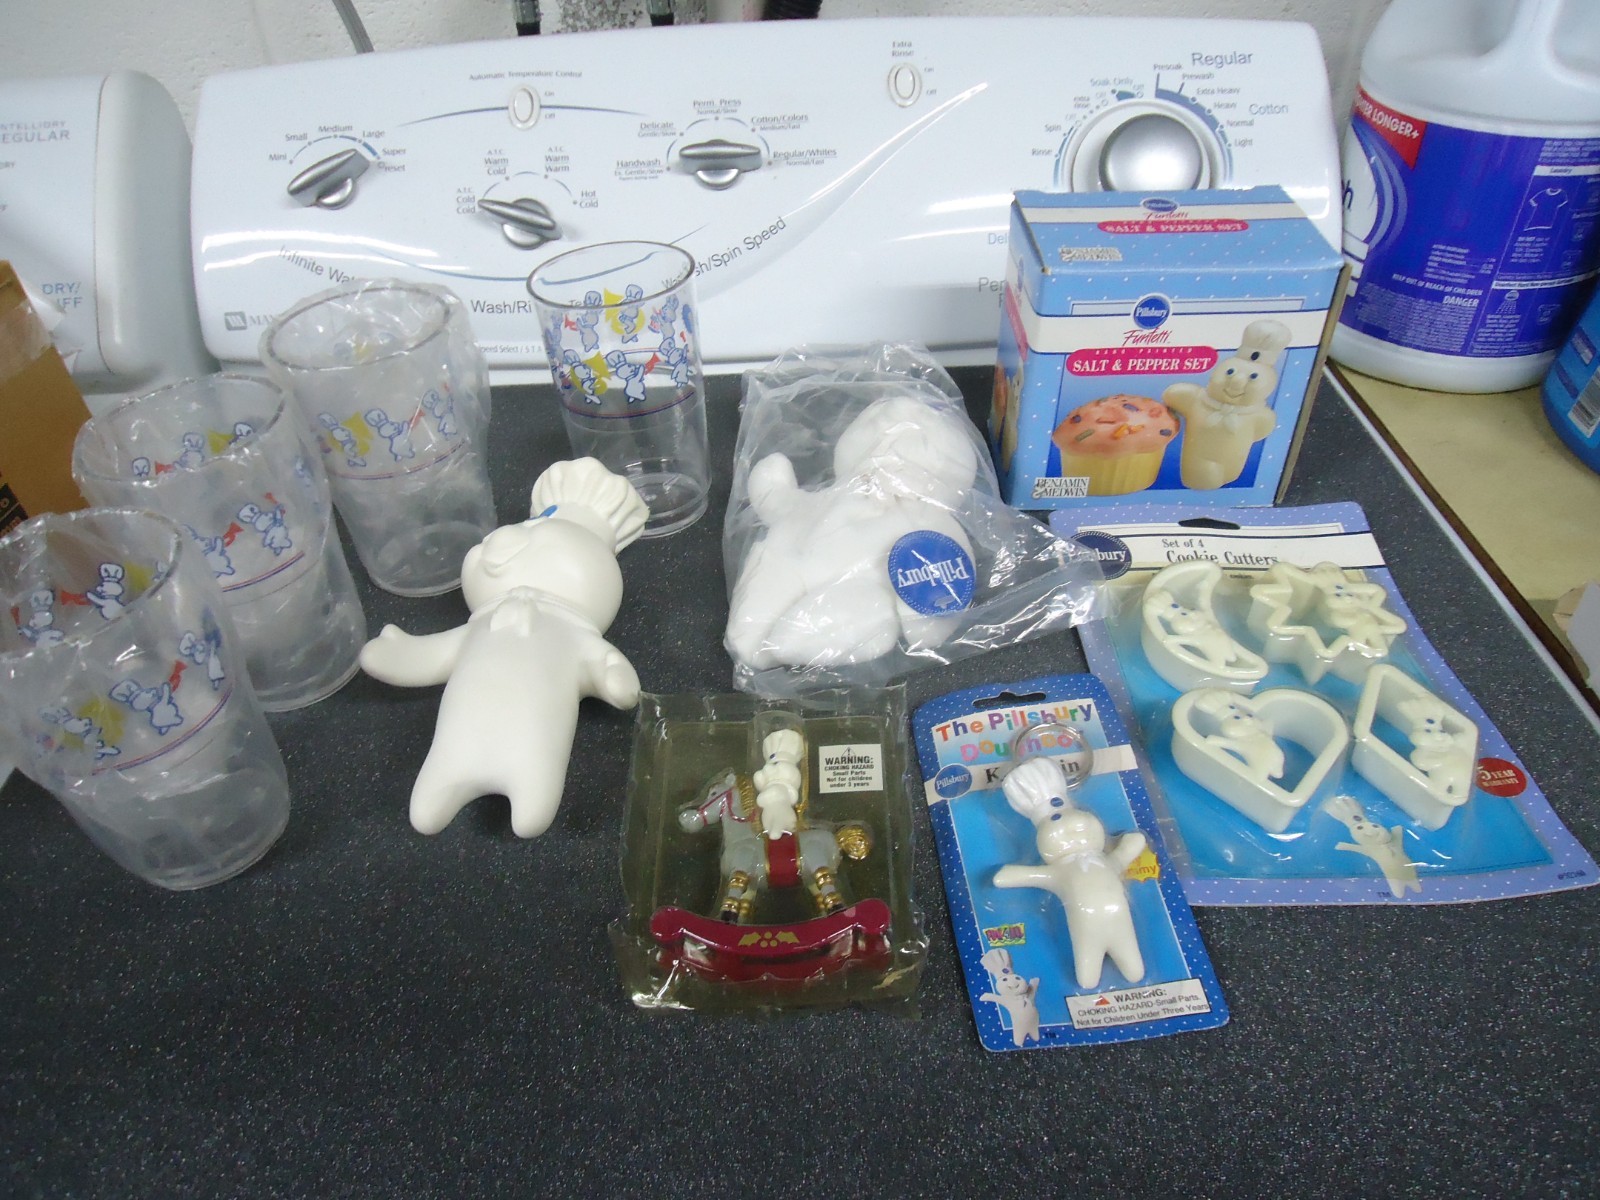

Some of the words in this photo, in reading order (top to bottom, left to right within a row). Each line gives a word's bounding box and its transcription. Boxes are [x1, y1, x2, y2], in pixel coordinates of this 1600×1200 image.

[1191, 51, 1254, 68] Regular
[469, 72, 505, 80] Automatic
[508, 70, 553, 79] Temperature
[555, 69, 583, 77] Control
[719, 98, 741, 107] Press
[1248, 103, 1289, 116] Cotton
[751, 113, 809, 123] Cotton/Colors
[0, 120, 66, 130] NTELLIDRY
[318, 124, 353, 133] Medium
[640, 121, 675, 129] Delicate
[1044, 123, 1062, 133] Spin
[0, 129, 71, 144] EGULAR
[285, 133, 308, 142] Small
[362, 130, 385, 140] Large
[1234, 138, 1253, 148] Light
[268, 152, 287, 162] Mini
[382, 147, 406, 157] Super
[773, 148, 838, 160] Regular/Whites
[484, 157, 509, 165] Warm
[545, 154, 570, 163] Warm
[616, 159, 661, 168] Handwash
[487, 167, 507, 175] Cold
[545, 164, 570, 173] Warm
[581, 190, 597, 198] Hot
[456, 195, 476, 204] Cold
[579, 200, 599, 209] Cold
[456, 206, 476, 215] Cold
[743, 216, 786, 250] Speed
[988, 231, 1009, 246] Del
[1442, 295, 1480, 307] DANGER
[471, 300, 533, 314] Wash/Ri
[1072, 359, 1109, 373] SALT
[1112, 359, 1123, 371] &
[1127, 358, 1180, 371] PEPPER
[1182, 357, 1212, 370] SET
[1036, 478, 1089, 489] BENJAMIN
[1043, 487, 1087, 497] MEDWIN
[1162, 538, 1180, 548] Set
[1183, 538, 1195, 548] of
[1198, 539, 1205, 548] 4
[1095, 548, 1126, 561] bury
[1224, 551, 1279, 565] Cutters
[897, 556, 970, 588] Pillsbury
[935, 720, 984, 742] The
[988, 703, 1093, 731] Pillsbury
[825, 755, 874, 765] WARNING:
[1477, 766, 1491, 780] 5
[1491, 769, 1516, 779] YEAR
[936, 773, 971, 790] Pillsbury
[1114, 988, 1168, 1003] WARNING:
[1076, 1017, 1091, 1027] Not
[1091, 1015, 1103, 1025] for
[1104, 1012, 1136, 1024] Children
[1137, 1009, 1161, 1020] Under
[1162, 1005, 1185, 1016] Three
[1078, 1005, 1118, 1017] CHOKING
